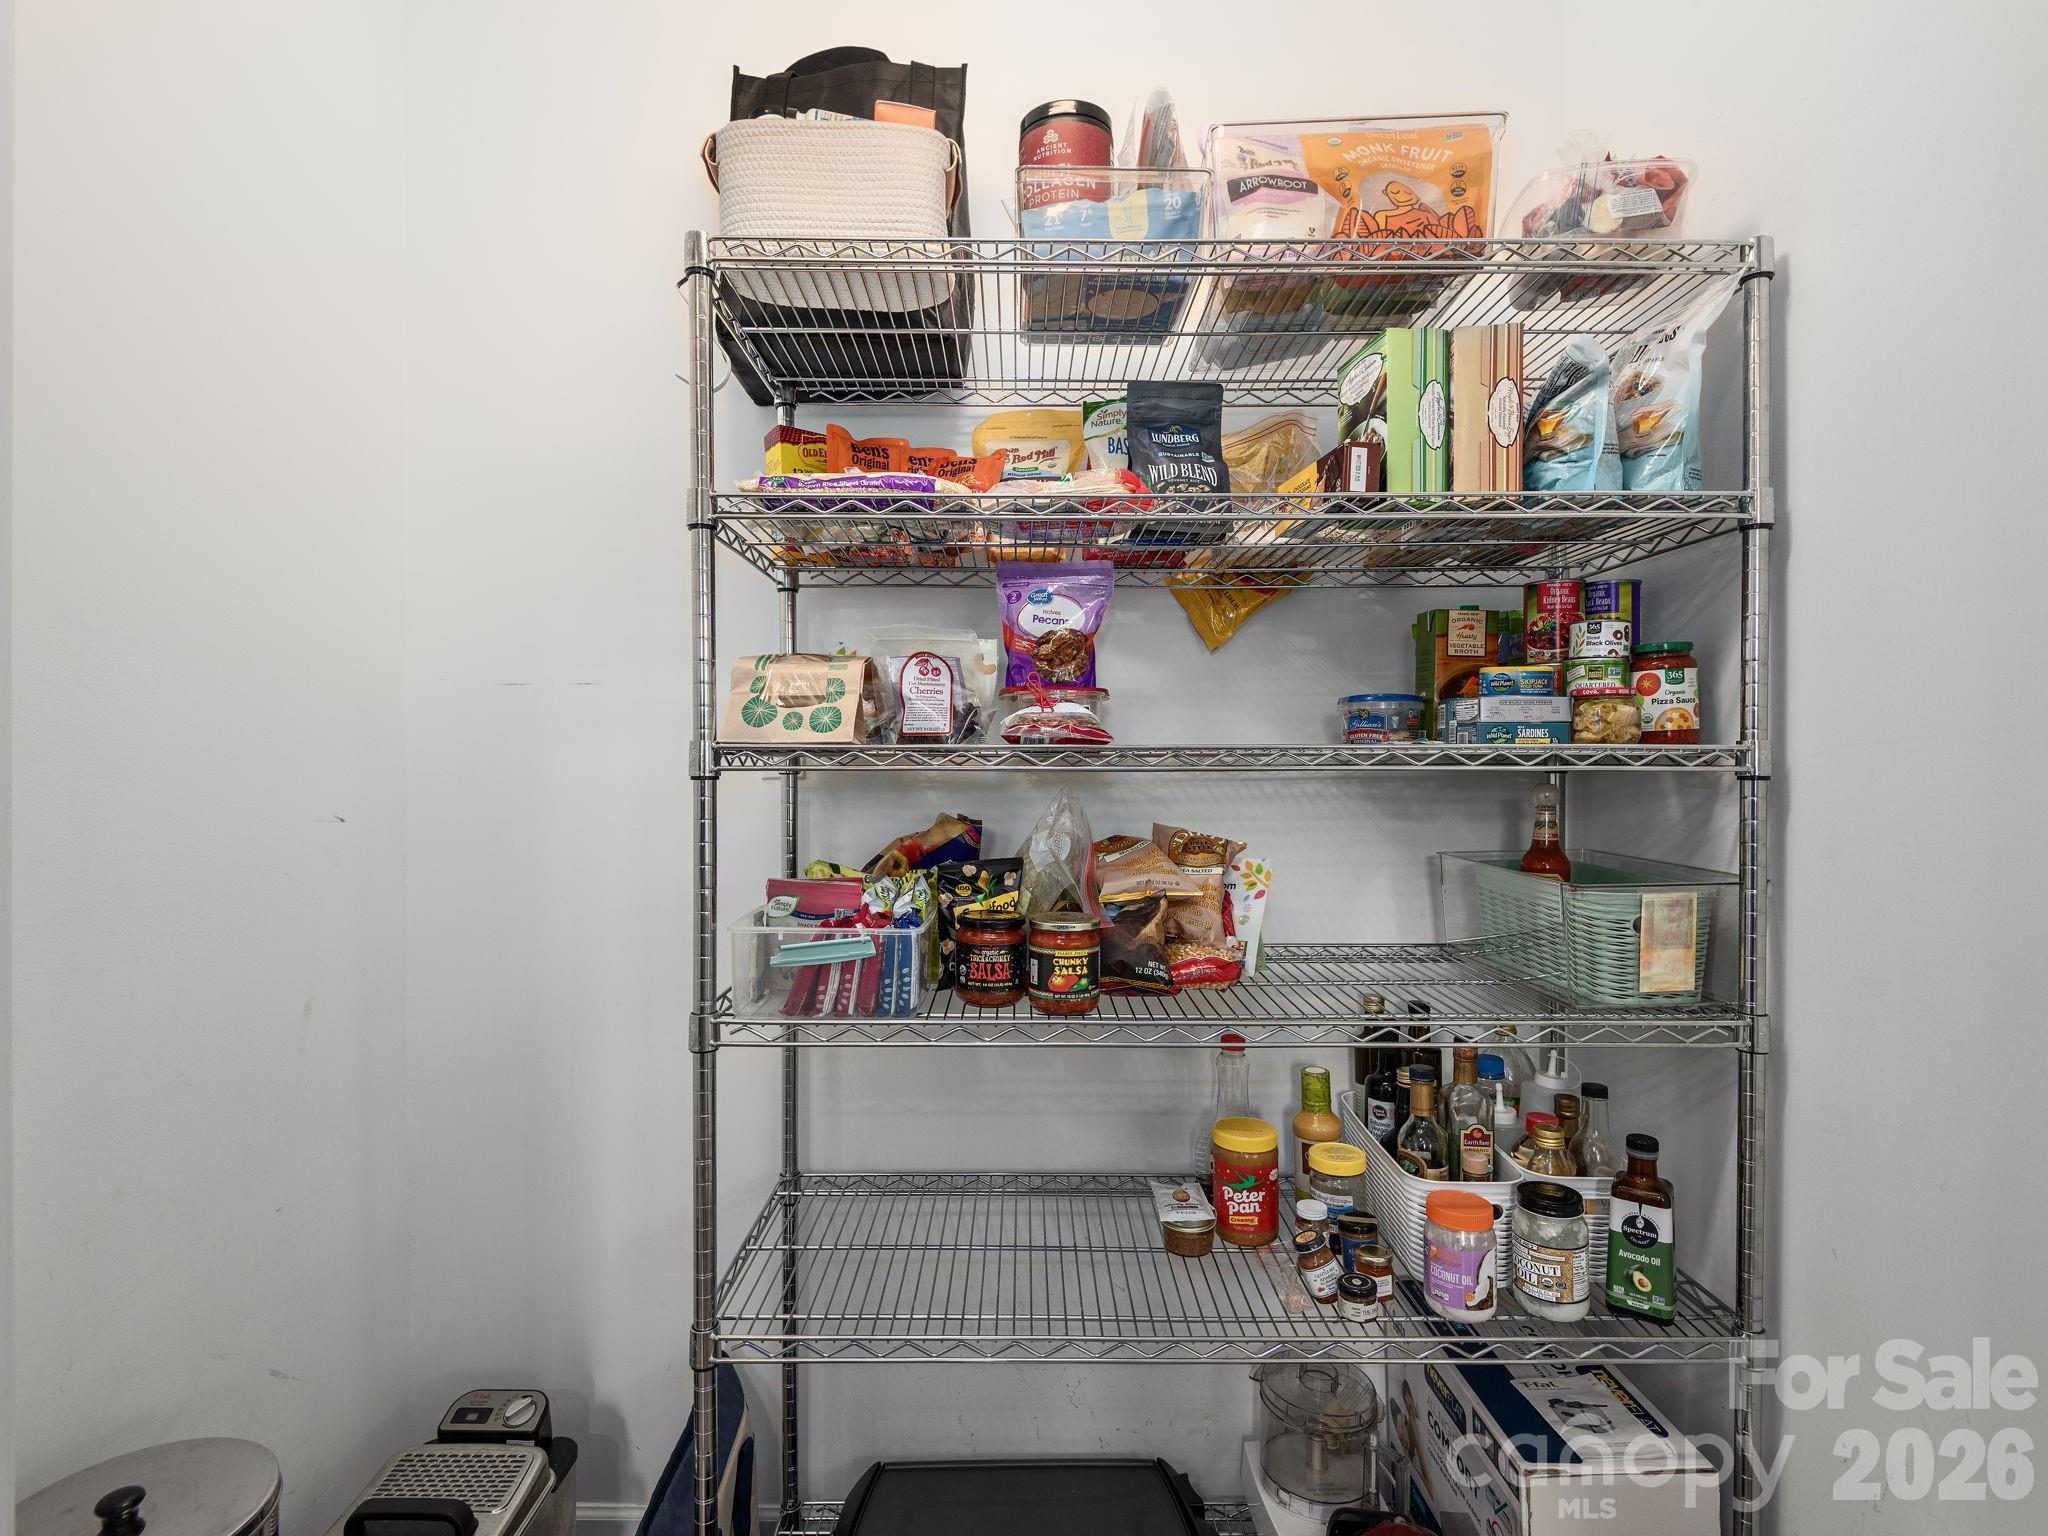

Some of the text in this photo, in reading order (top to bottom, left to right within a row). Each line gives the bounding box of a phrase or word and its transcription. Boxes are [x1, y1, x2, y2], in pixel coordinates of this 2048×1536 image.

[1037, 142, 1067, 154] ANCIENT
[1342, 143, 1454, 163] MONK FRUIT
[1033, 148, 1072, 161] NUTRITION
[1240, 176, 1307, 193] ARROWROOT
[1029, 189, 1080, 207] PROTEIN
[1164, 196, 1182, 210] 20
[1096, 409, 1128, 422] Simply
[1151, 432, 1200, 444] LUNDBERG
[908, 455, 935, 467] en's
[1011, 446, 1056, 465] Red Mill
[851, 454, 890, 471] Original
[938, 465, 975, 477] Original
[1148, 462, 1218, 487] WILD BLEND
[1030, 592, 1048, 600] Great
[1549, 587, 1569, 595] Organic
[1543, 595, 1576, 604] Kidney Beans
[1032, 614, 1071, 626] Pecans
[1456, 632, 1478, 641] Hearty
[1666, 671, 1683, 679] 365
[909, 687, 944, 695] Cherries
[1651, 696, 1696, 706] Pizza Sauce
[1349, 720, 1382, 728] Gillian's
[1517, 729, 1549, 738] SARDINES
[773, 899, 792, 909] Simply
[1052, 958, 1088, 966] CHUNKY
[970, 962, 1012, 980] SALSA
[1054, 966, 1088, 975] SALSA
[1369, 1118, 1392, 1127] Balsamic
[1222, 1186, 1266, 1203] Peter
[1622, 1225, 1657, 1239] Spectrum
[1618, 1249, 1661, 1266] Avocado Oil
[1430, 1265, 1474, 1286] COCONUT OIL
[1518, 1267, 1536, 1284] OIL
